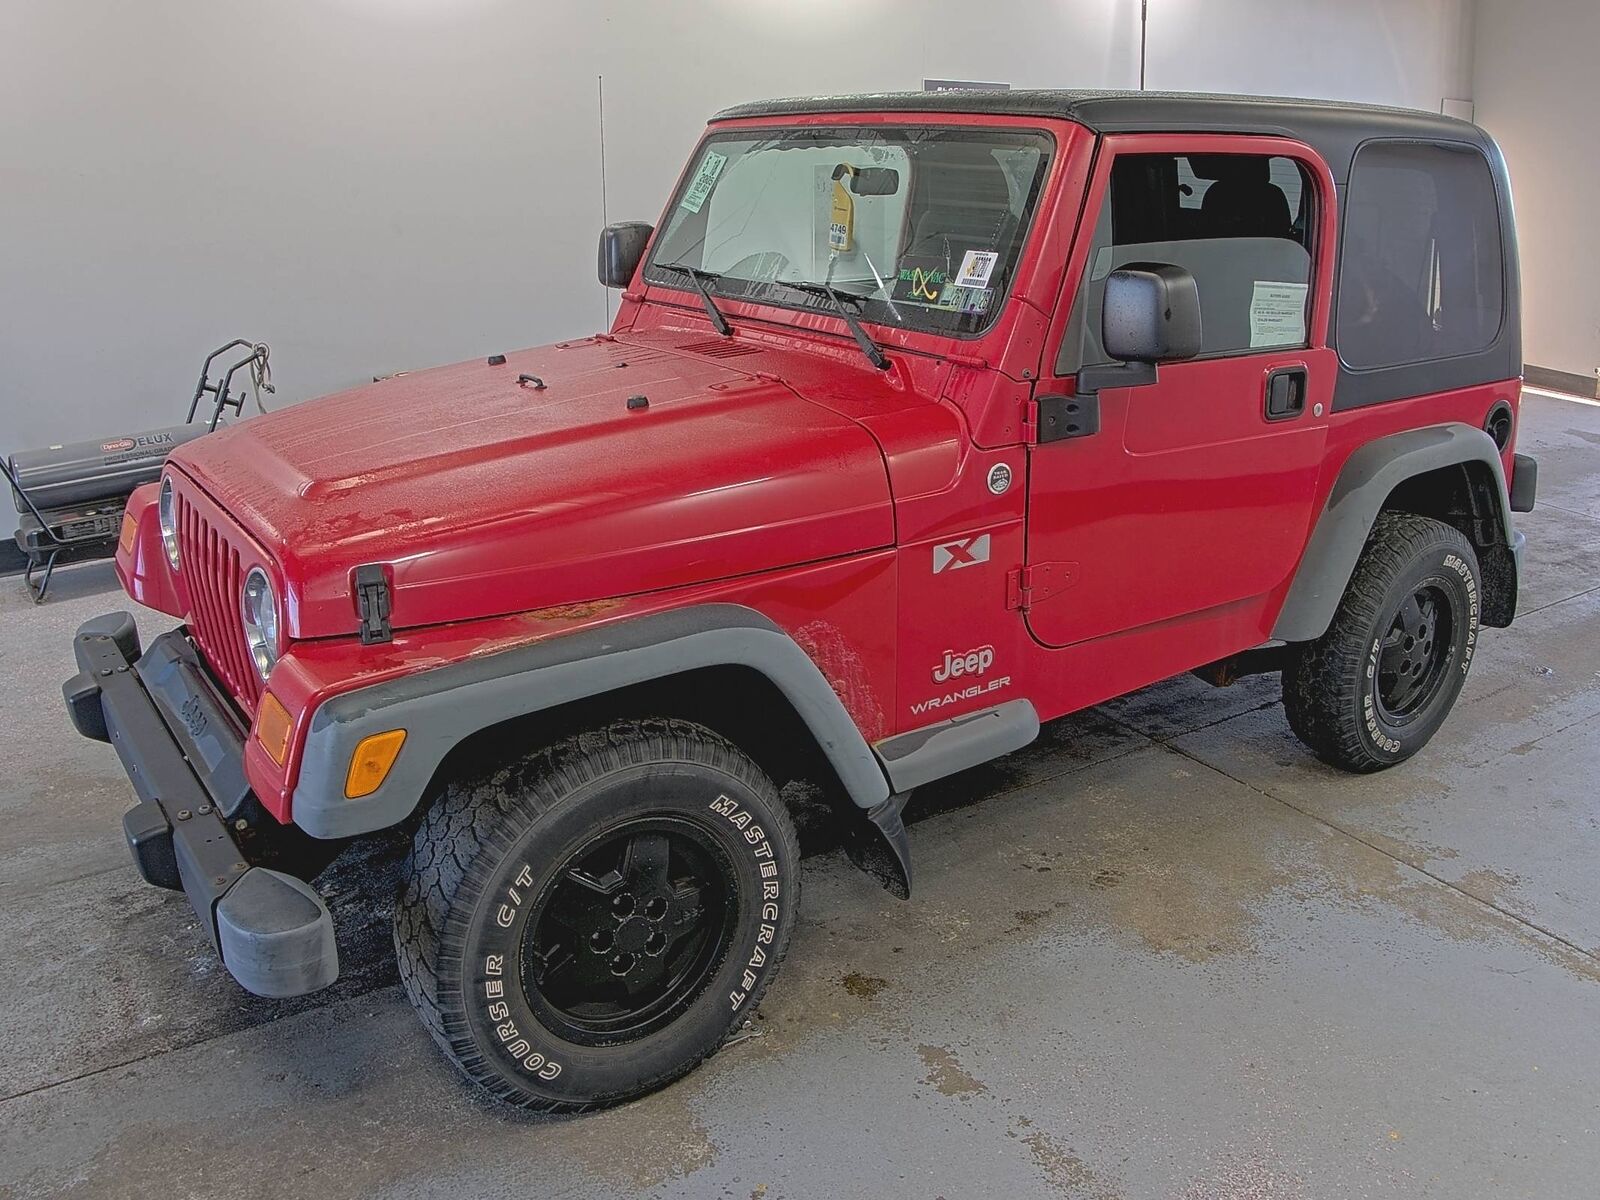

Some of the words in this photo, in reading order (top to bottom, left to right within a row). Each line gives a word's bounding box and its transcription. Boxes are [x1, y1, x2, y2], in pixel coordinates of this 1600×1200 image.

[830, 223, 847, 235] 4749
[104, 449, 153, 462] PROFESSIONAL
[1442, 553, 1479, 675] MASTERCRAFT
[933, 645, 994, 684] Jeep
[910, 675, 1011, 716] WRANGLER
[1363, 695, 1401, 753] COURSER
[496, 864, 536, 929] C/T
[709, 793, 780, 1012] MASTERCRAFT
[485, 953, 563, 1082] COURSER
